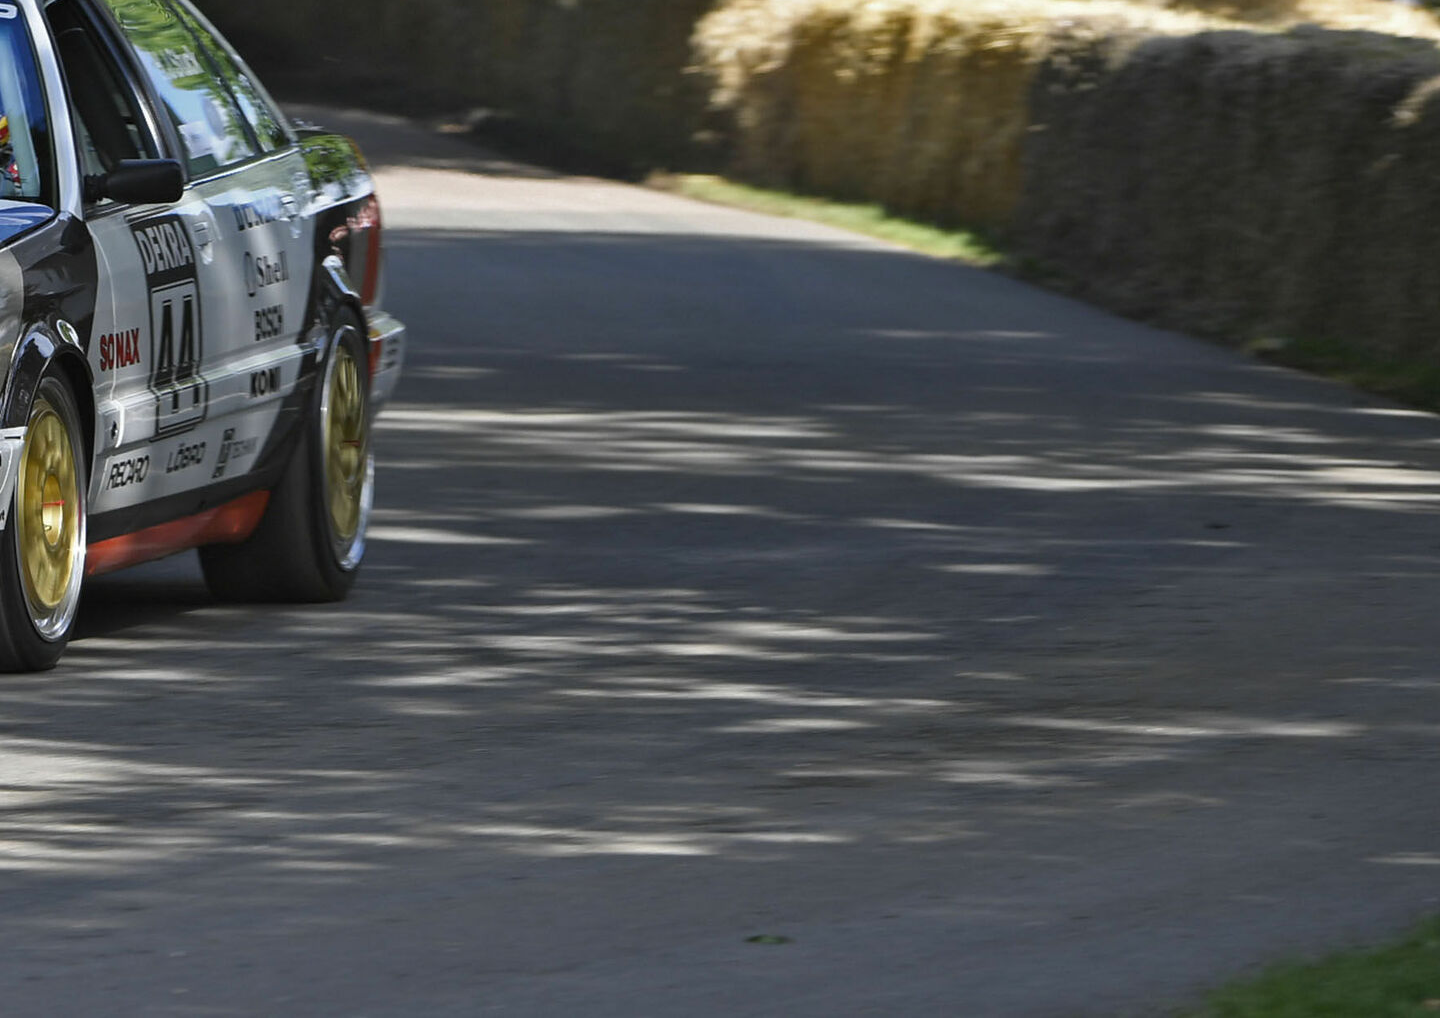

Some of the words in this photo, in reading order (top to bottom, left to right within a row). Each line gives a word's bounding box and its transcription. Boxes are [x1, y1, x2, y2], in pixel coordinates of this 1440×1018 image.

[134, 220, 194, 275] DEKRA
[98, 327, 140, 372] SONAX
[152, 294, 200, 414] 44
[106, 454, 151, 491] RECARO
